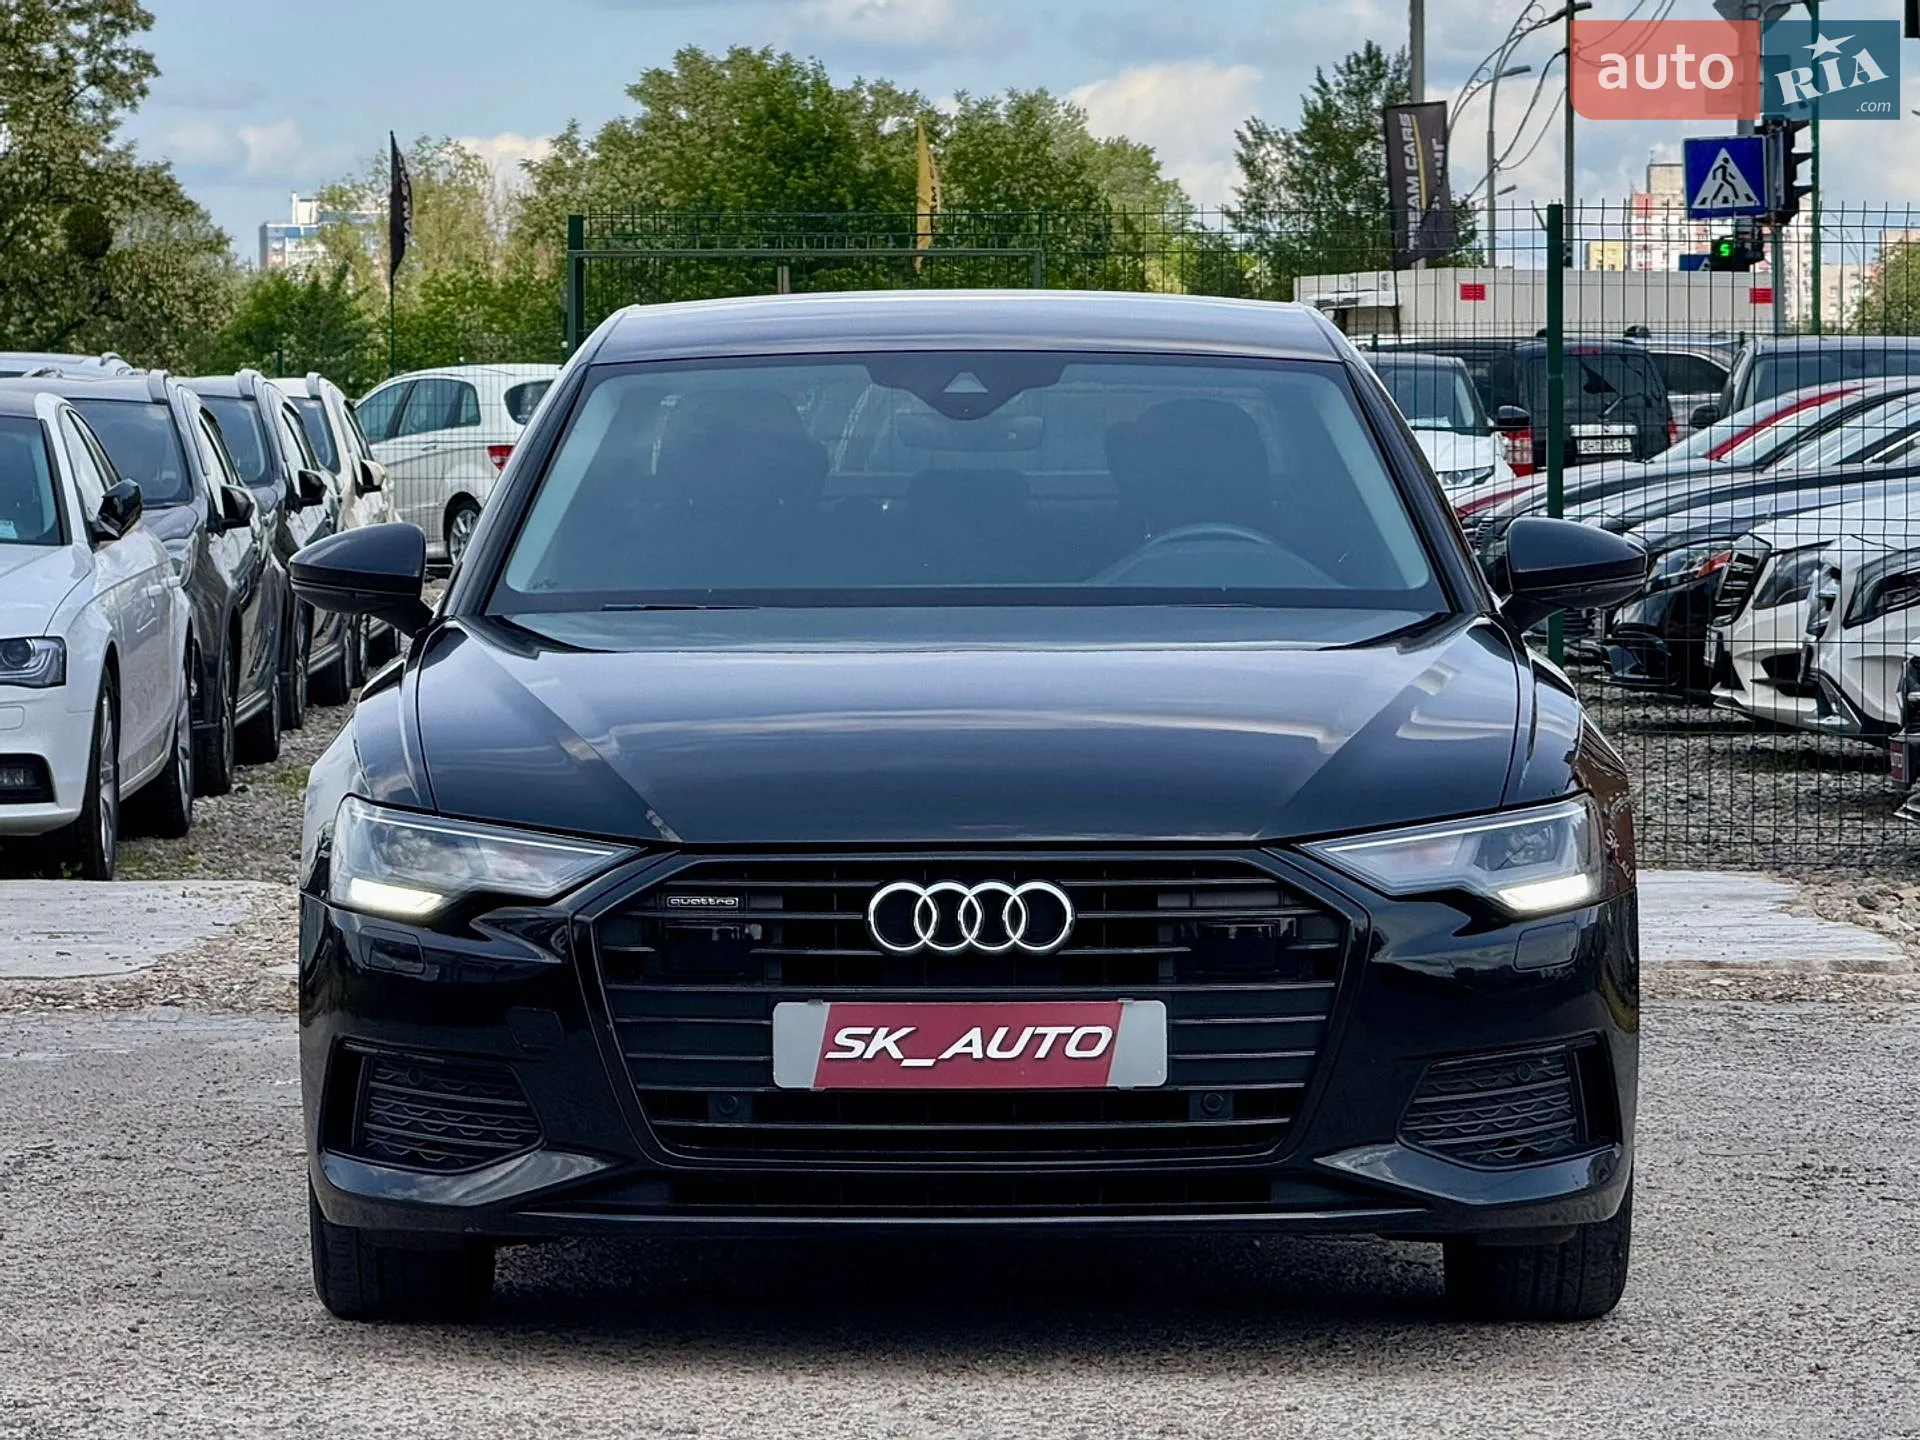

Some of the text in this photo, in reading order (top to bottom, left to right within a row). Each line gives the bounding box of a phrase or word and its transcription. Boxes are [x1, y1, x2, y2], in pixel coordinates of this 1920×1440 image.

[1398, 113, 1418, 171] CARS
[669, 897, 736, 907] quattro
[824, 1026, 1114, 1067] SK_AUTO
